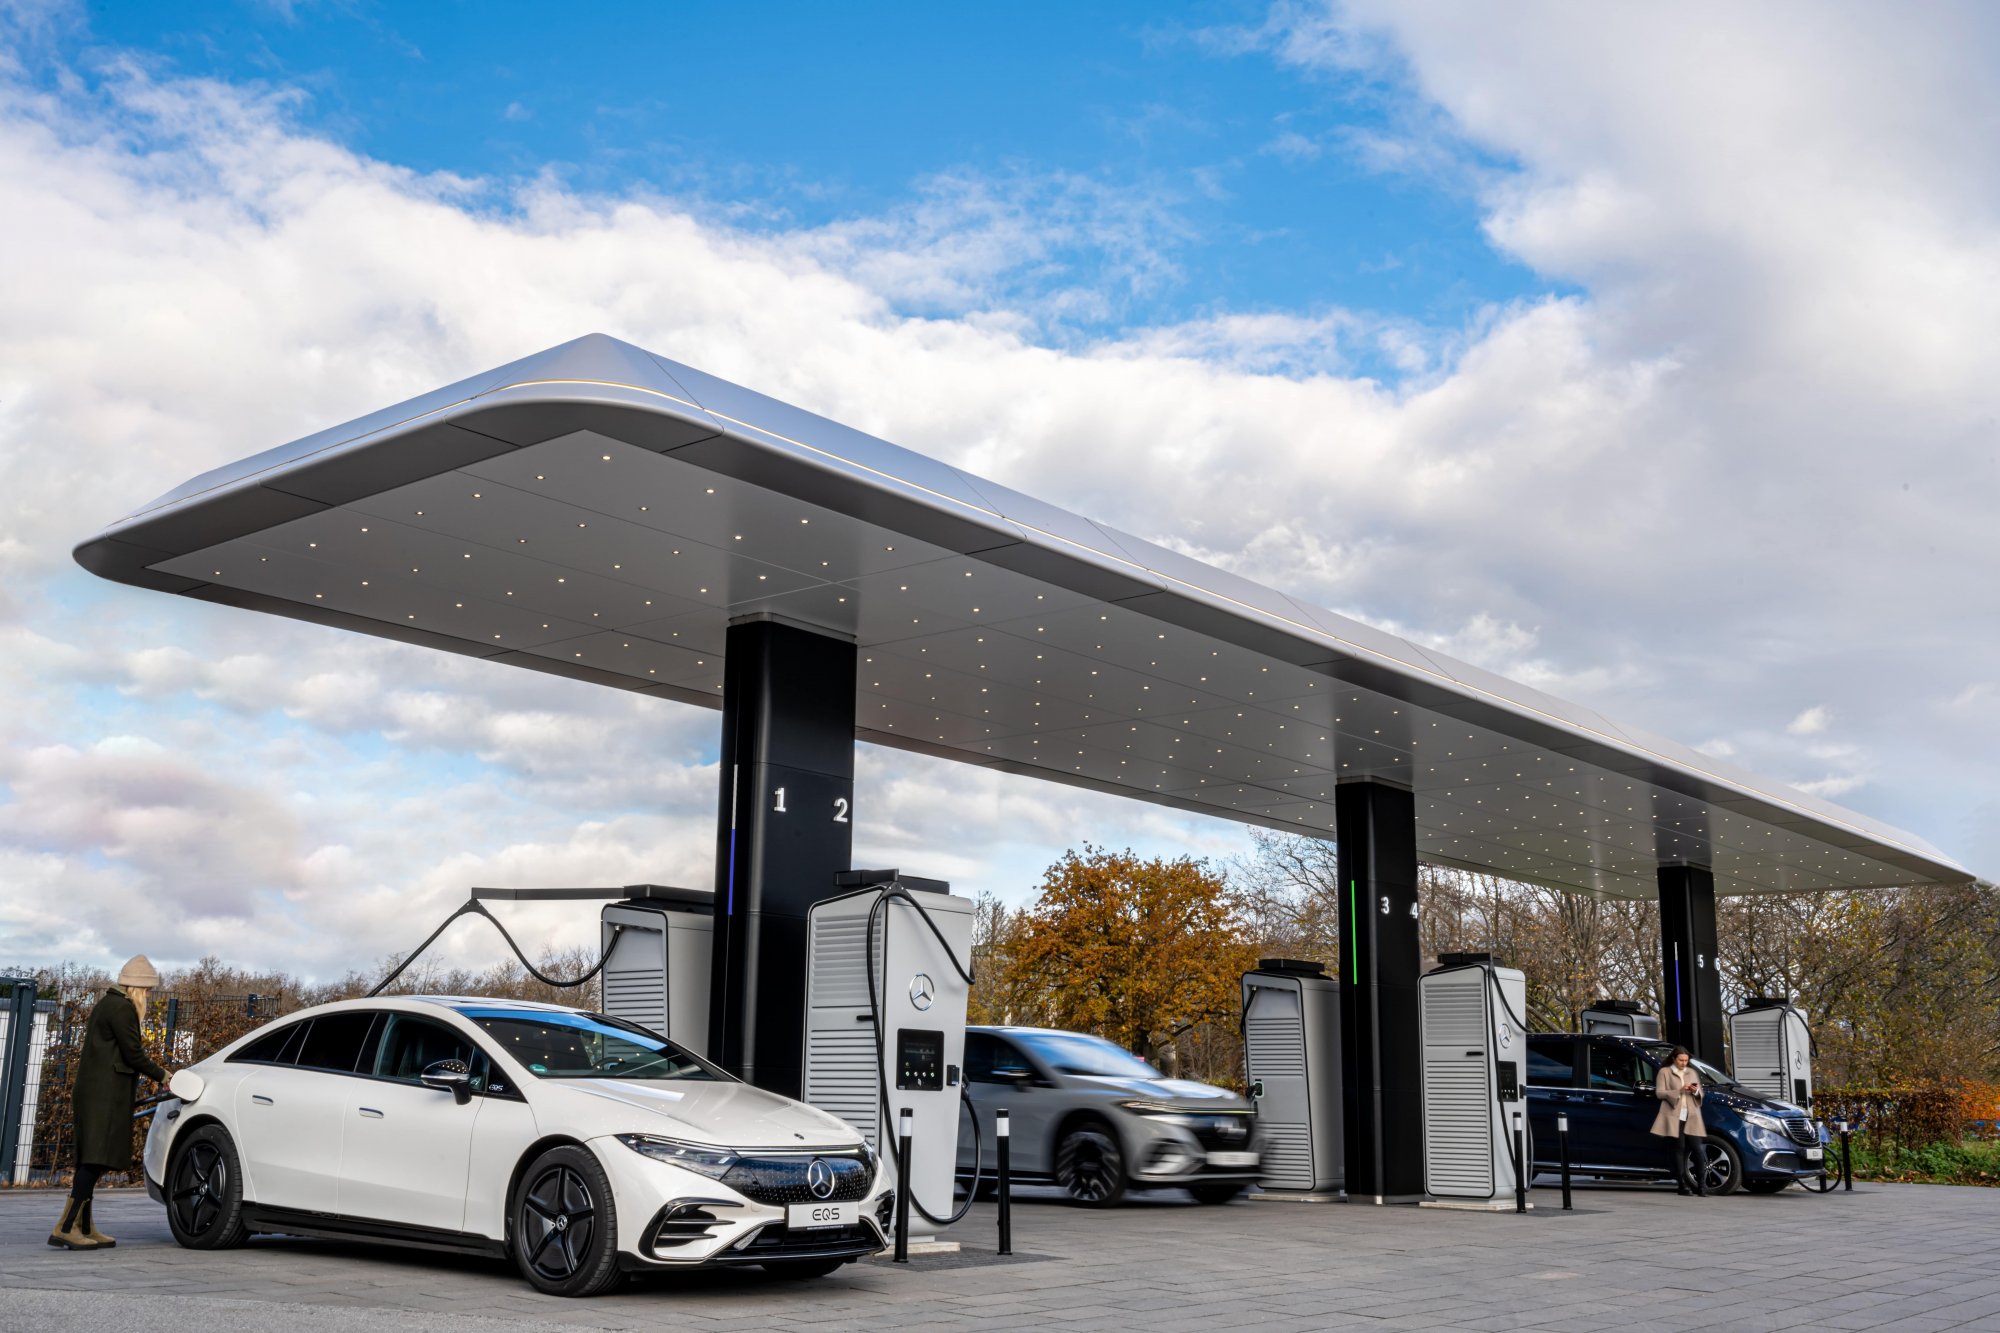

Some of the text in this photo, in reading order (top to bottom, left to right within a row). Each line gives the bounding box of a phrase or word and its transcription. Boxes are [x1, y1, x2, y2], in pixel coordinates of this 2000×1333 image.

[773, 787, 787, 812] 1
[833, 797, 848, 822] 2
[1380, 896, 1390, 915] 3
[1409, 902, 1419, 919] 4
[1697, 954, 1704, 968] 5
[812, 1207, 840, 1221] EQS
